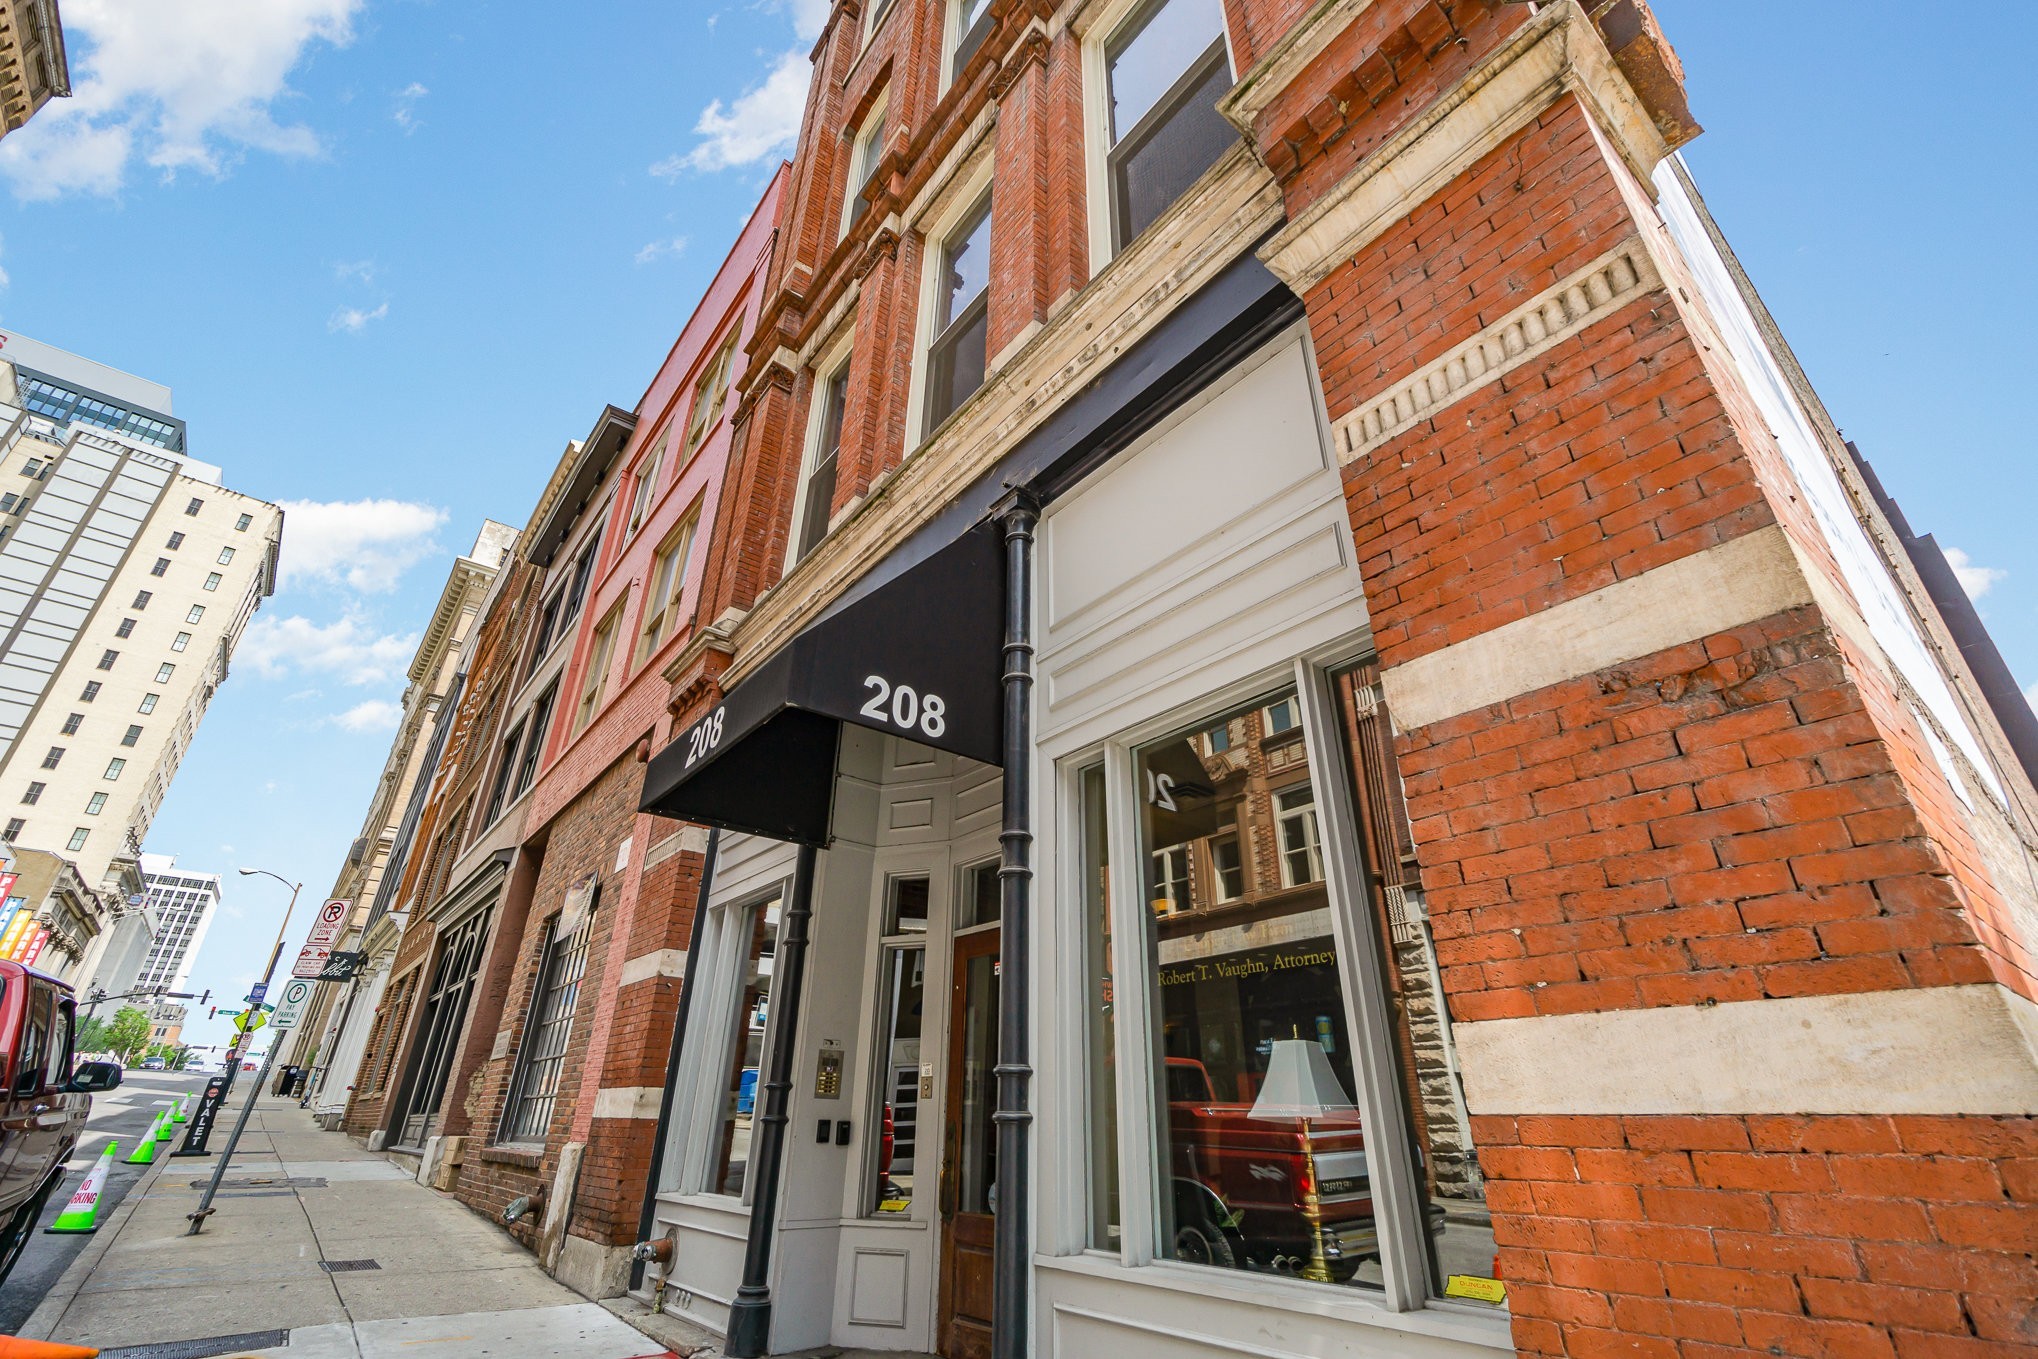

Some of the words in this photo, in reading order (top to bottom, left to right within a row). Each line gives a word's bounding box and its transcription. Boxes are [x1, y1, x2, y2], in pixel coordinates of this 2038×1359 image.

[858, 674, 948, 738] 208
[684, 705, 726, 769] 208
[1, 912, 28, 952] PARK
[11, 923, 37, 961] PARK
[316, 922, 340, 930] LOADING
[22, 931, 46, 966] PARK
[1157, 969, 1196, 987] Robert
[1198, 965, 1213, 981] T.
[1215, 958, 1269, 978] Vaughn,
[1273, 949, 1336, 971] Attorney
[278, 1011, 298, 1019] PARKING
[192, 1099, 215, 1146] VALET
[80, 1179, 92, 1191] NO
[1459, 1280, 1493, 1290] DUNCAN
